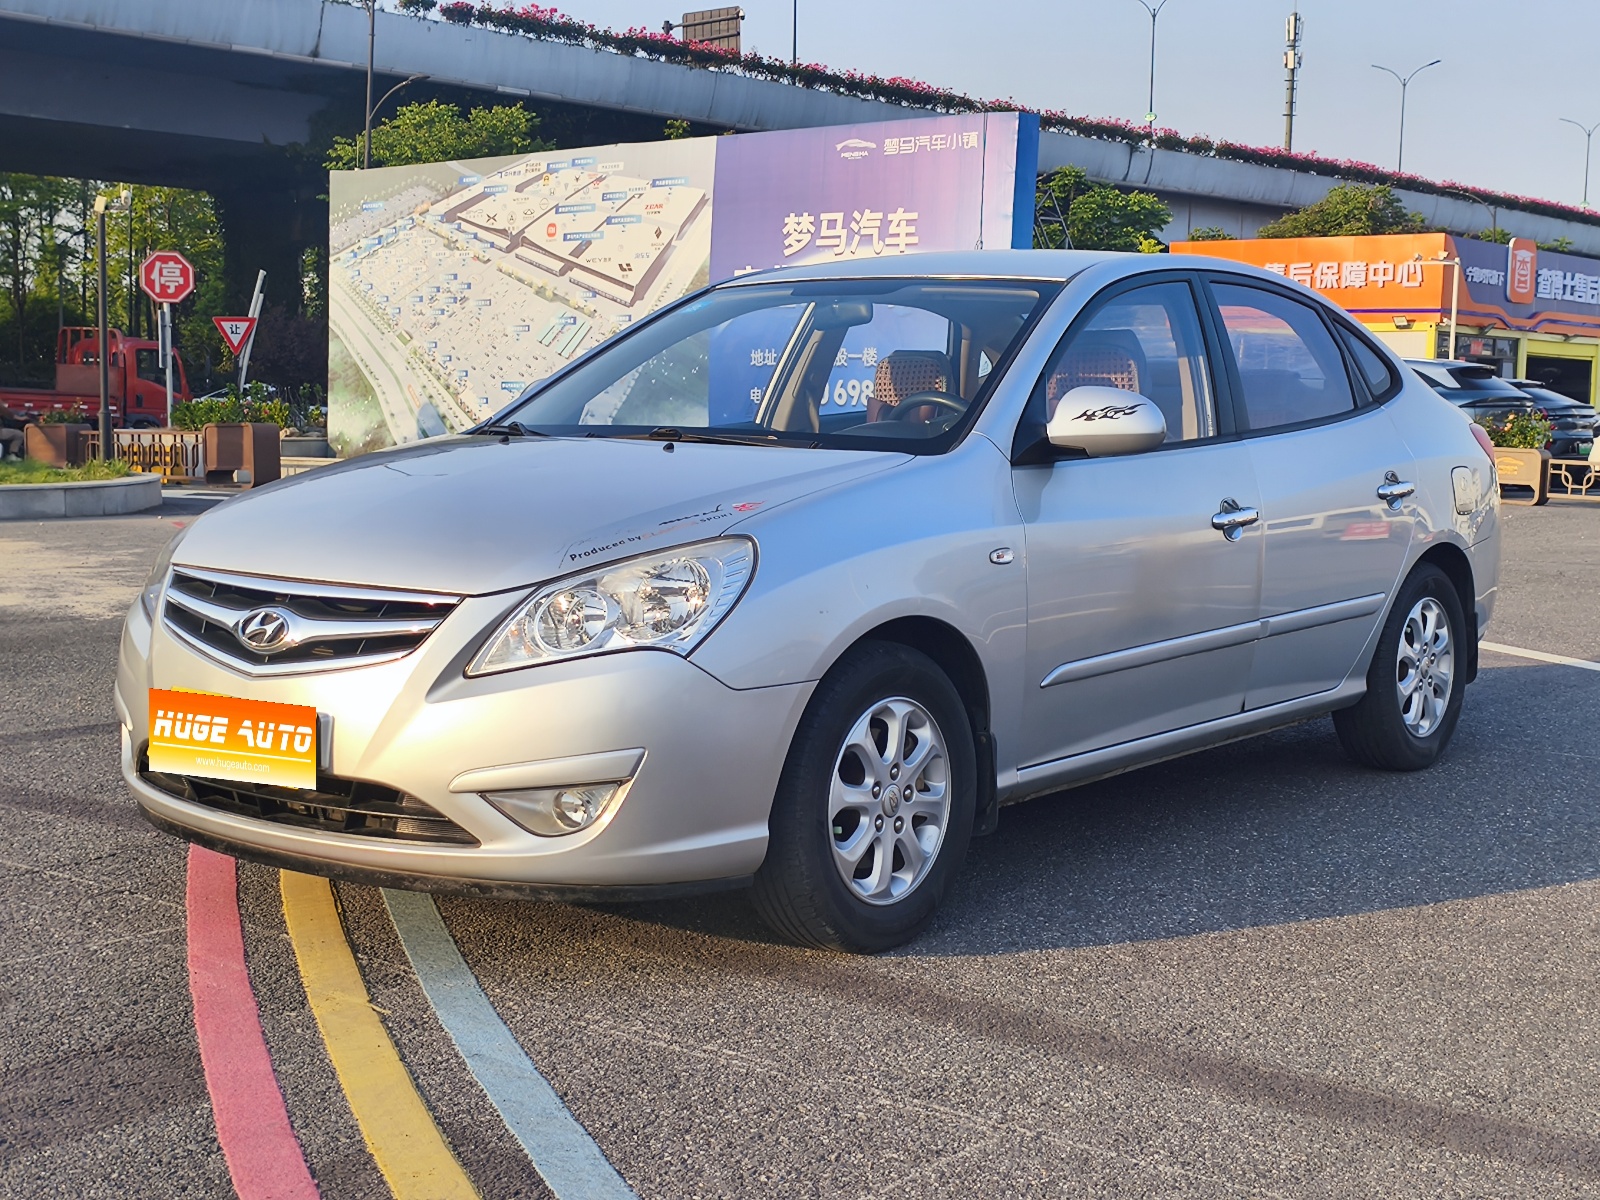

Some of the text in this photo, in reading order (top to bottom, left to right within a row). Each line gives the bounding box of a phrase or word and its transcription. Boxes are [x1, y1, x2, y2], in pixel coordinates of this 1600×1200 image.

[883, 131, 979, 157] 梦马汽车小镇
[782, 207, 920, 257] 梦马汽车
[151, 261, 184, 294] 停
[1537, 268, 1600, 305] 查博士售后
[229, 323, 241, 336] 让
[750, 348, 777, 366] 地址
[750, 387, 766, 404] 电
[570, 539, 626, 561] Produced
[628, 535, 642, 543] by
